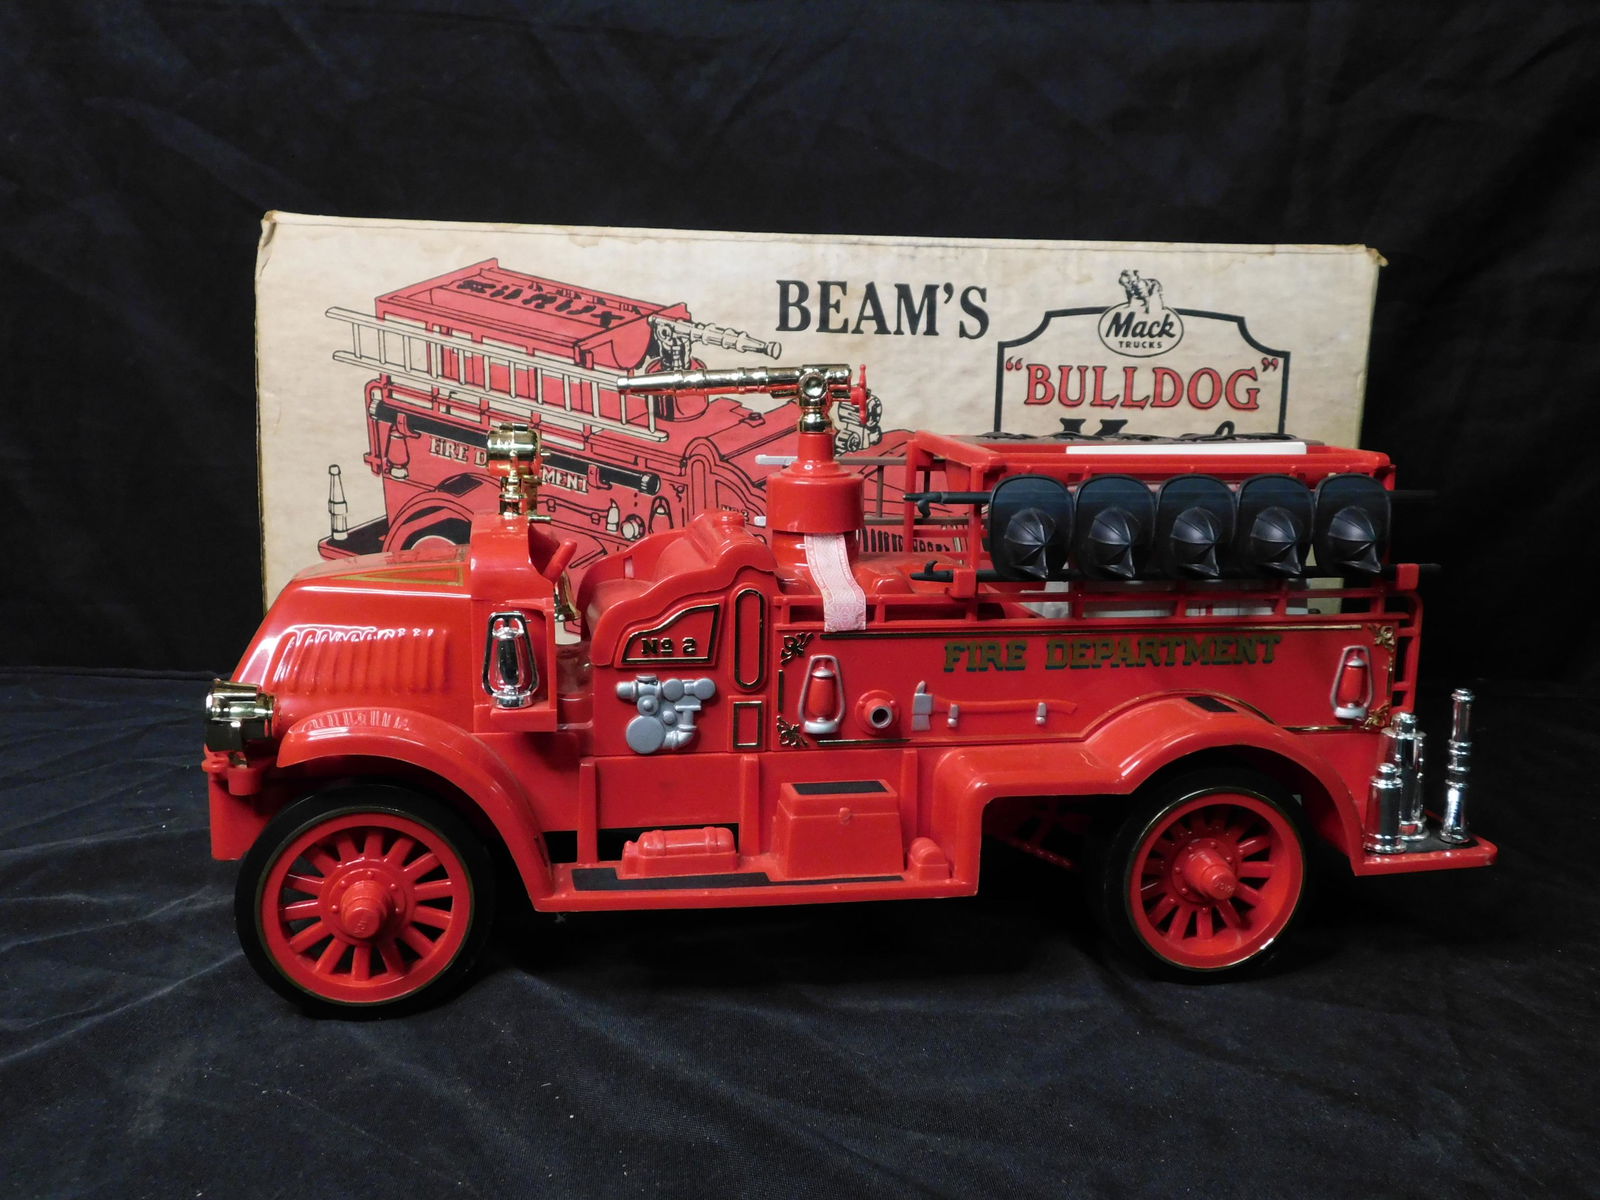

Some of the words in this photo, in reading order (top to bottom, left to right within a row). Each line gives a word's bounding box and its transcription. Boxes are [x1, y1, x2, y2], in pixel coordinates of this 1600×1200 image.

[775, 279, 990, 340] BEAM'S
[1105, 311, 1176, 338] Mack
[1118, 340, 1163, 349] TRUCKS
[1005, 355, 1279, 411] "BULLDOG"
[430, 436, 469, 463] FIRE
[682, 637, 697, 655] 2
[944, 639, 1028, 672] FIRE
[1045, 634, 1283, 670] DEPARTMENT
